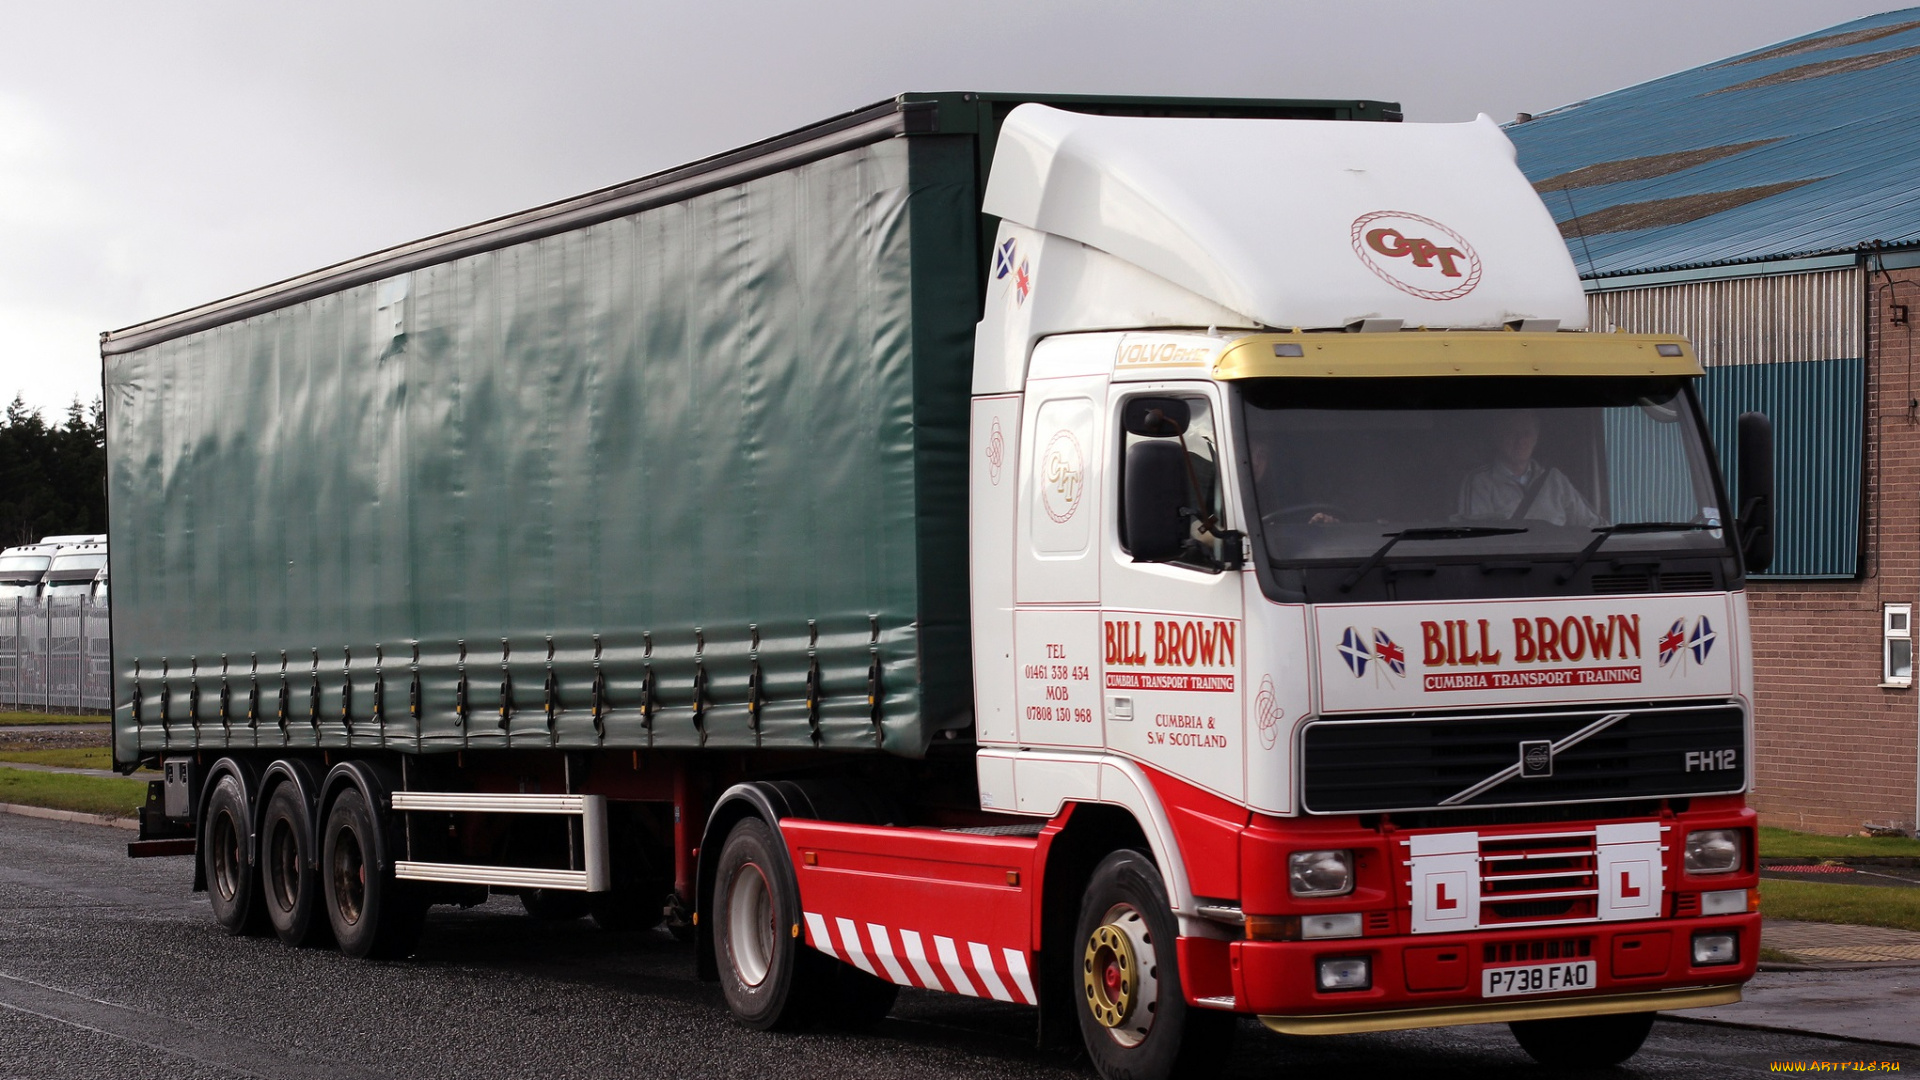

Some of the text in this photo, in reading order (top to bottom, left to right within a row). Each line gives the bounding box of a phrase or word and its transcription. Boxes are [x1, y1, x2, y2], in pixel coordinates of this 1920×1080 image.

[1366, 228, 1466, 278] CTT
[1118, 343, 1177, 363] VOLVO
[1105, 620, 1236, 668] BILL BROWN
[1421, 614, 1641, 667] BILL BROWN
[1047, 644, 1066, 659] TEL
[1025, 665, 1089, 681] 01461 338 434
[1106, 674, 1234, 690] CUMBRIA TRANSPORT TRAINING
[1425, 668, 1640, 690] CUMBRIA TRANSPORT TRAINING
[1046, 686, 1068, 701] MOB
[1026, 706, 1092, 723] 07808 130 968
[1155, 714, 1216, 730] CUMBRIA &
[1169, 732, 1227, 748] SCOTLAND
[1685, 749, 1736, 772] FH12
[1620, 871, 1640, 899] L
[1436, 882, 1457, 910] L
[1490, 964, 1588, 993] P738 FAO
